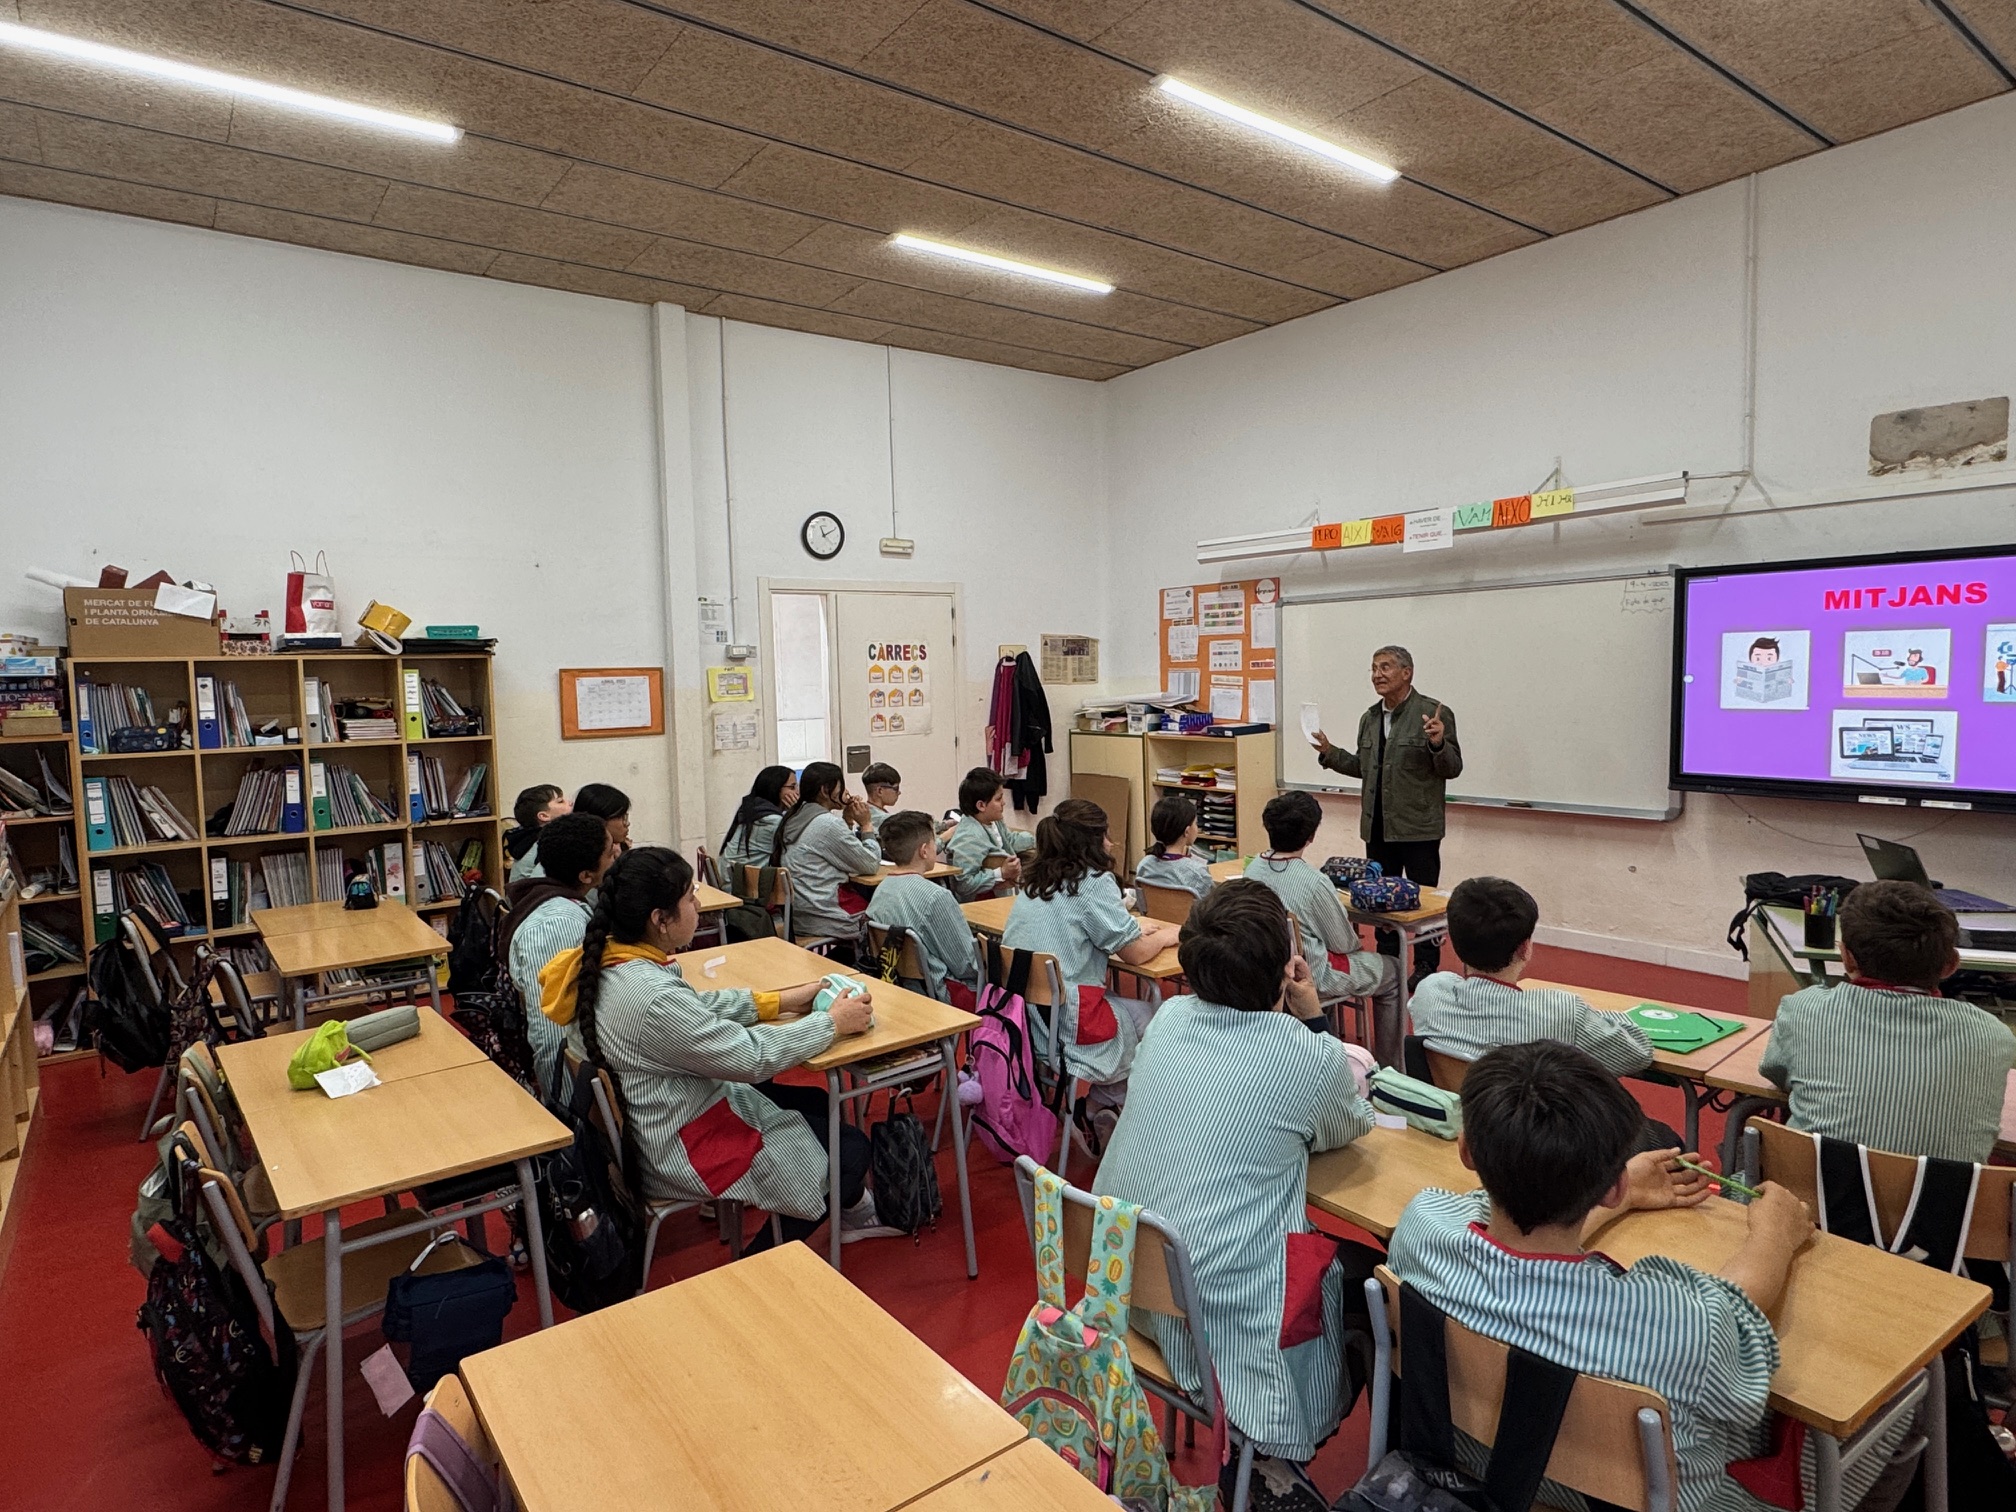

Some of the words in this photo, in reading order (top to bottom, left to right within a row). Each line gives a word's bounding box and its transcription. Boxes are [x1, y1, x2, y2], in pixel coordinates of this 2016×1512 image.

[84, 599, 125, 607] MERCAT
[1824, 582, 1988, 611] MITJANS
[102, 618, 159, 626] CATALUNYA
[868, 643, 927, 661] CÀRRECS
[1425, 1470, 1464, 1489] RVEL
